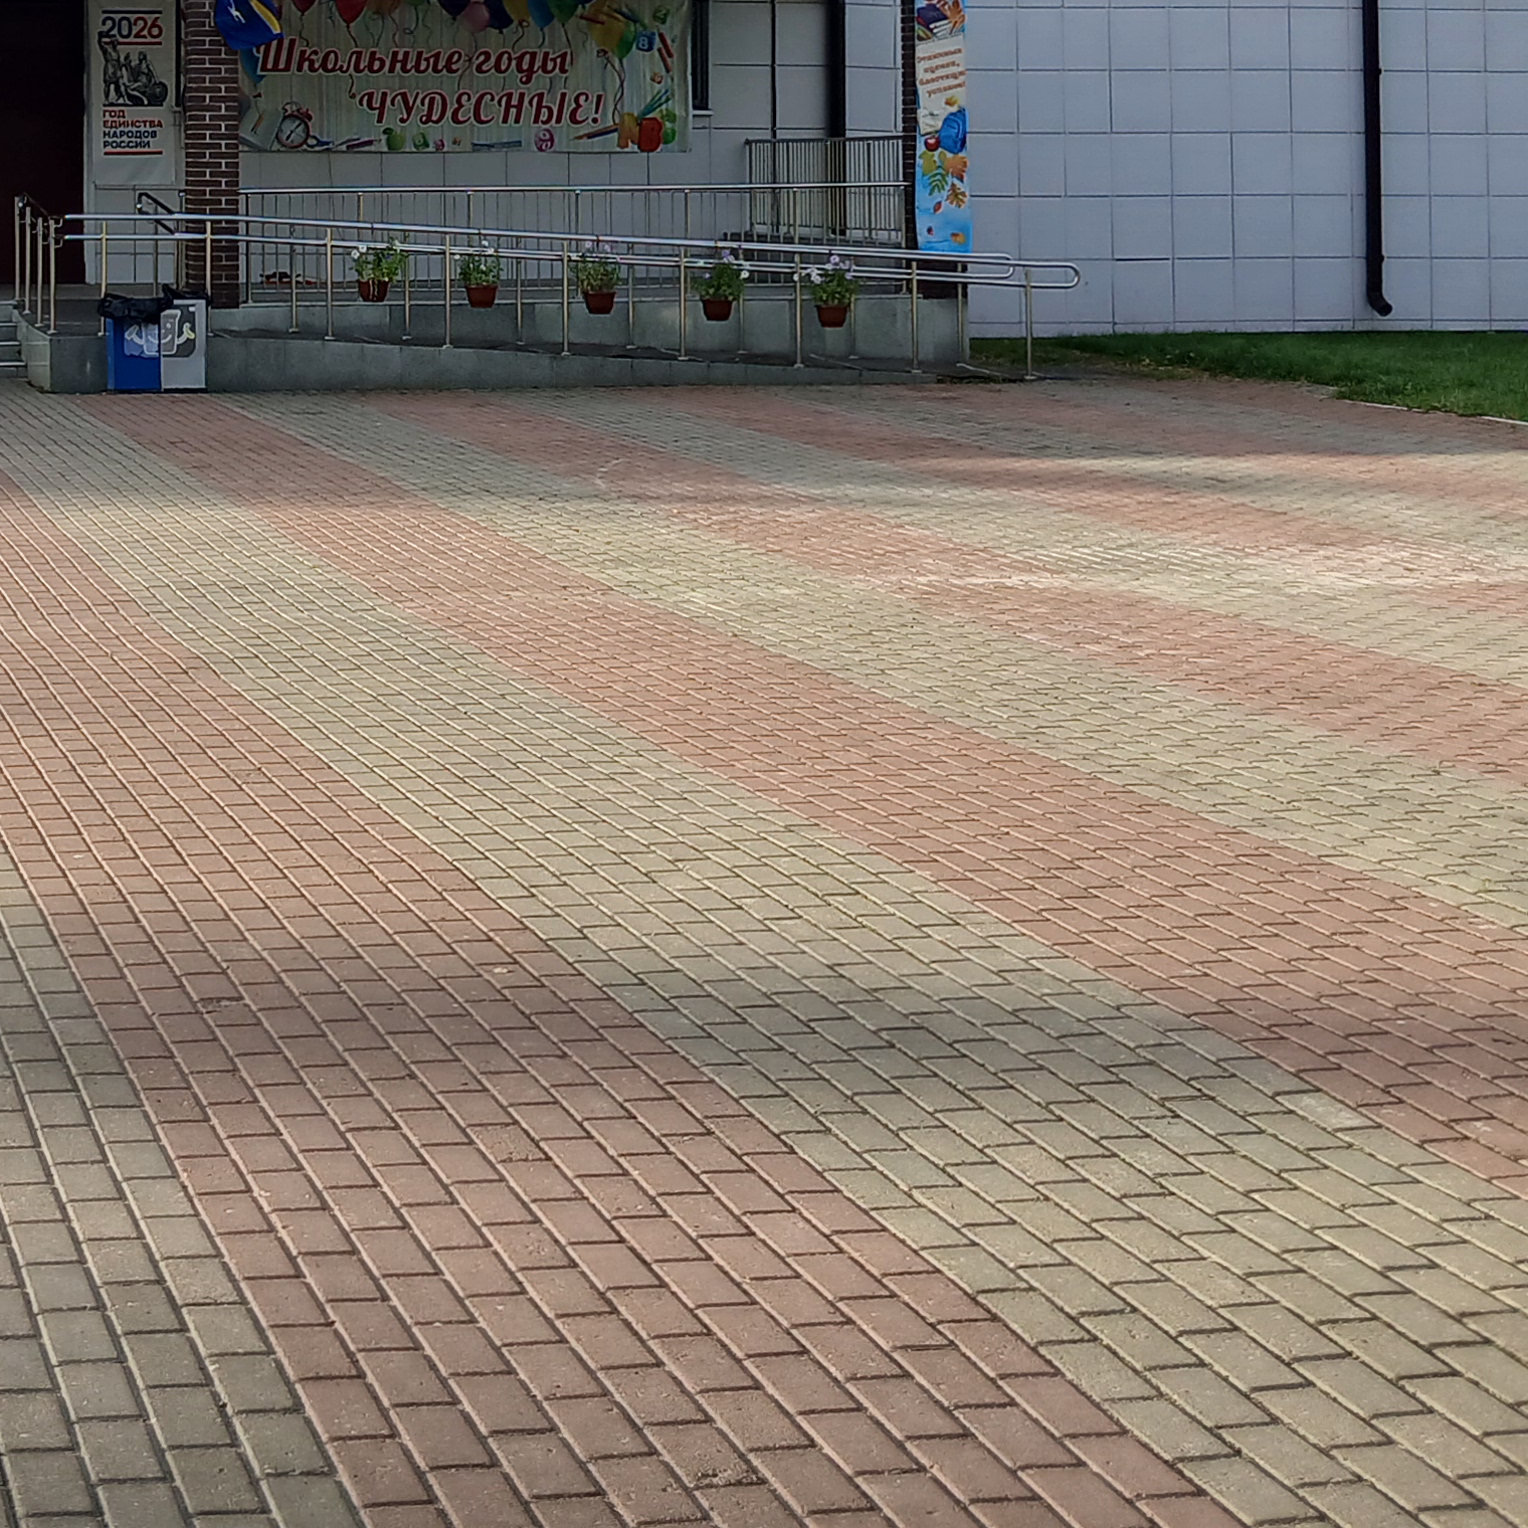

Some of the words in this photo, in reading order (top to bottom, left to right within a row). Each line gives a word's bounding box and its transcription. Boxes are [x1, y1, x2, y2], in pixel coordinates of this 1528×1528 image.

[101, 16, 163, 39] 2026
[256, 38, 461, 74] Школьные
[475, 49, 570, 84] годы
[103, 109, 126, 119] ГОД
[358, 92, 604, 126] ЧУДЕСНЫЕ!
[103, 120, 163, 129] ЕДИНСТВА
[103, 130, 157, 139] НАРОДОВ
[103, 140, 151, 149] РОССИИ
